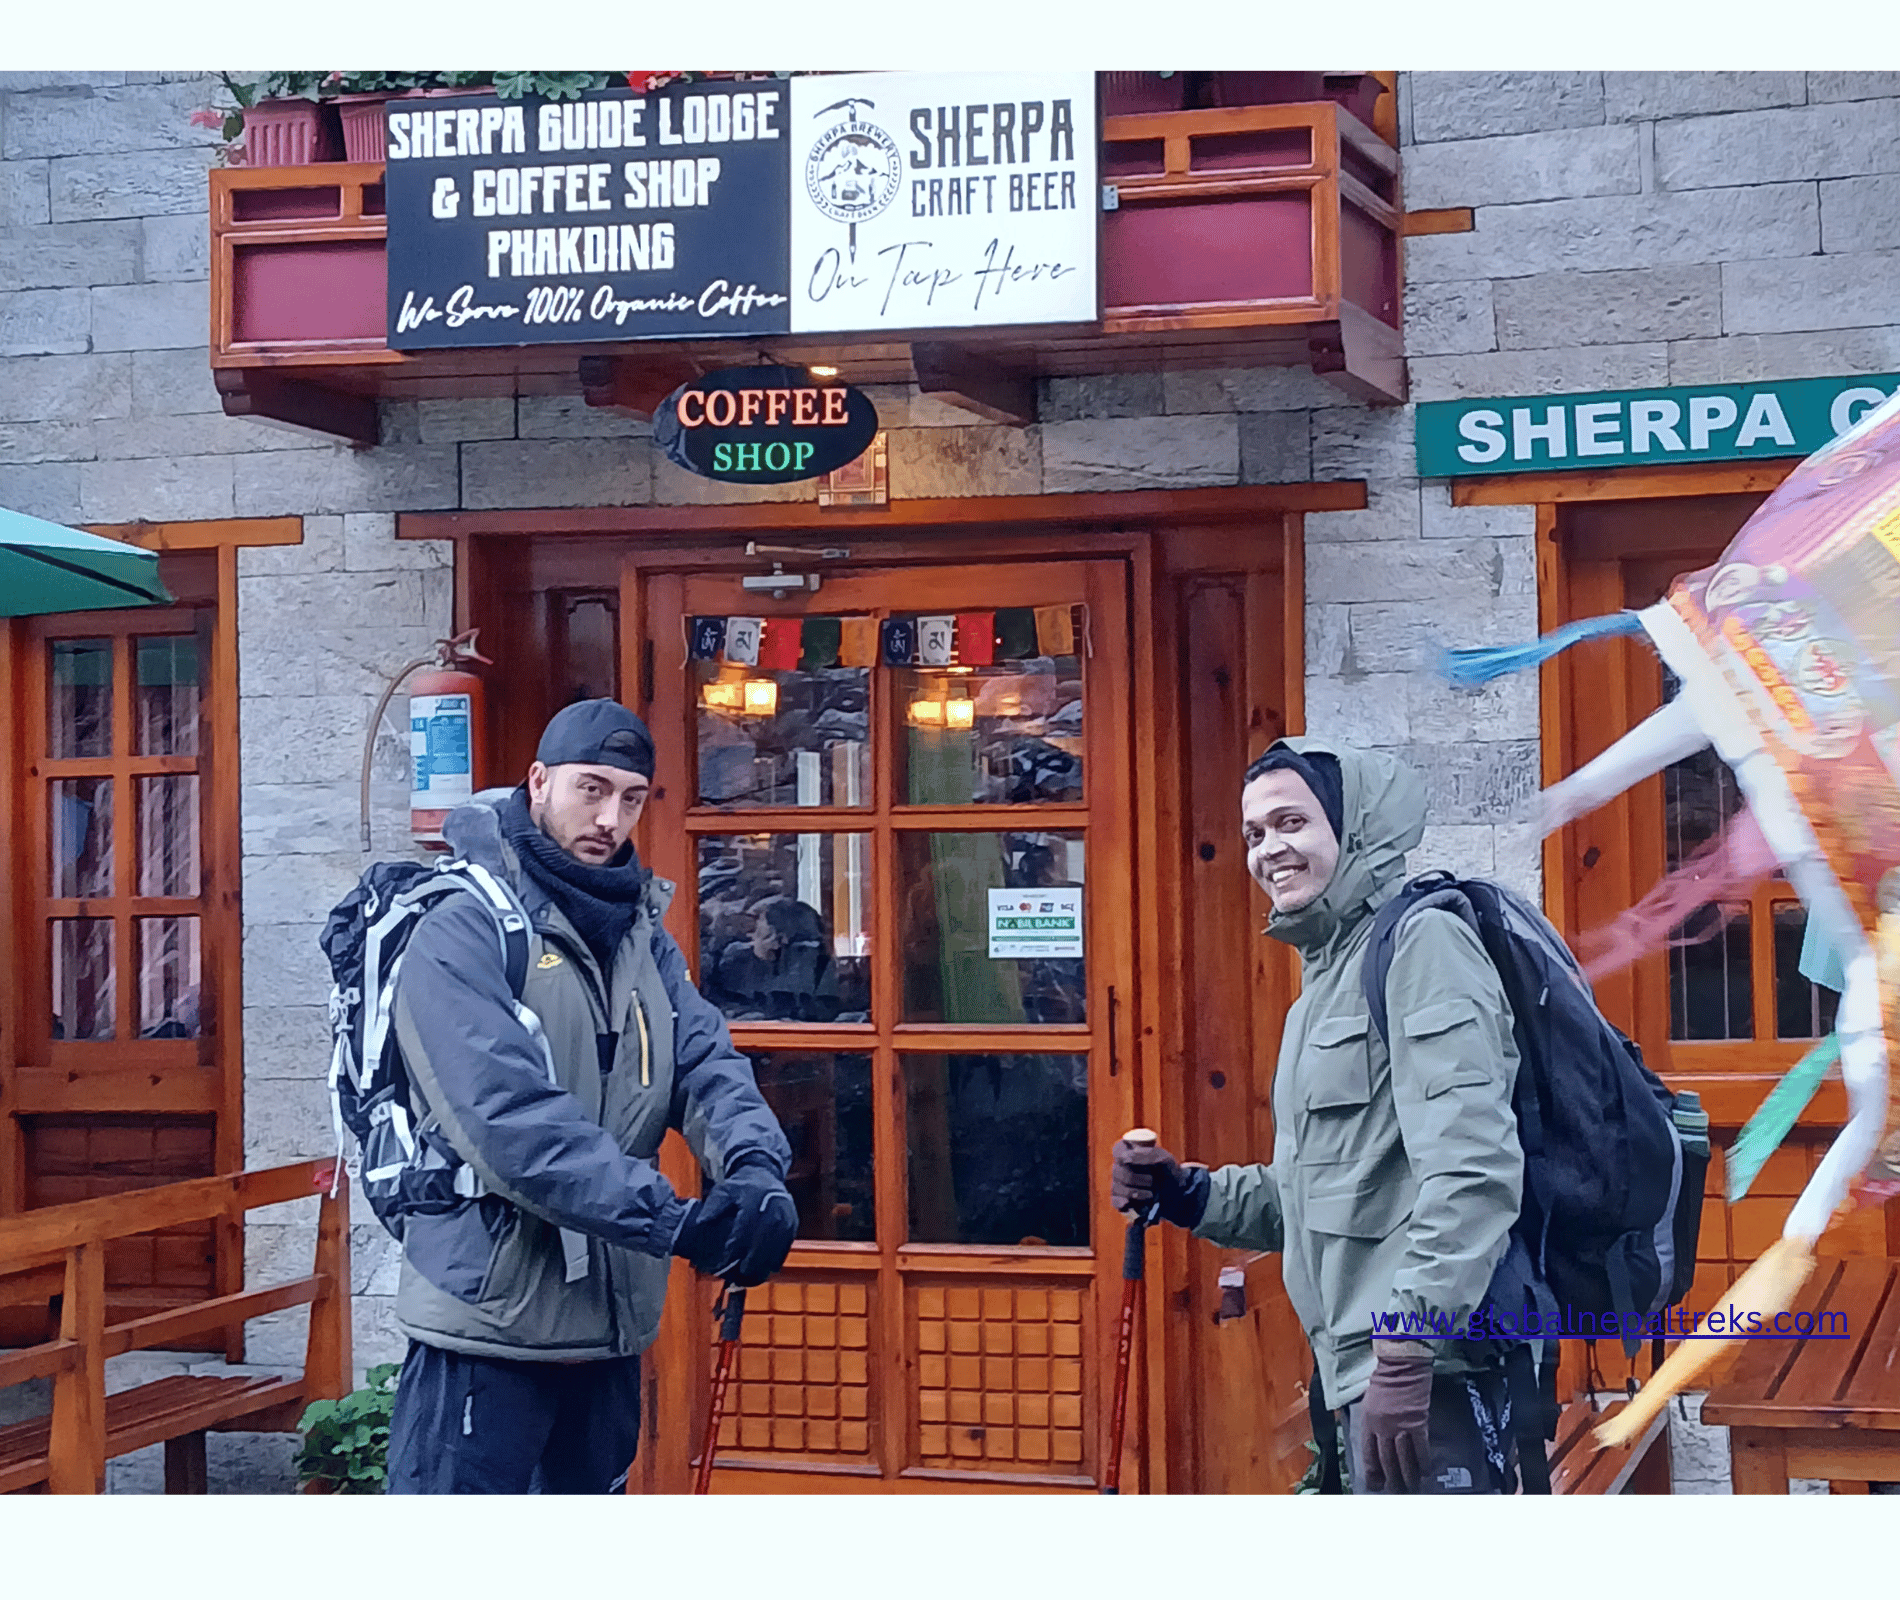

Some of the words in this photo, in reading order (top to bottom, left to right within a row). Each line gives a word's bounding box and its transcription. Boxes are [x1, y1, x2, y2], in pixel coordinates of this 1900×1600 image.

[388, 106, 525, 159] SHERPA
[538, 99, 646, 151] GUIDE
[659, 92, 780, 145] LODGE
[909, 99, 1074, 169] SHERPA
[432, 177, 460, 218] &
[472, 163, 612, 217] COFFEE
[624, 157, 721, 209] SHOP
[911, 175, 997, 217] CRAFT
[1009, 171, 1076, 212] BEER
[487, 223, 675, 277] PHAKDING
[808, 247, 868, 302] On
[878, 241, 963, 316] Tap
[974, 238, 1076, 311] Here
[396, 290, 443, 333] We
[446, 285, 519, 328] Serve
[523, 287, 584, 325] 100%
[590, 284, 695, 326] Organic
[698, 280, 788, 318] Coffee
[677, 388, 849, 427] COFFEE
[1457, 393, 1796, 463] SHERPA
[713, 442, 815, 471] SHOP
[1035, 918, 1070, 928] BANK
